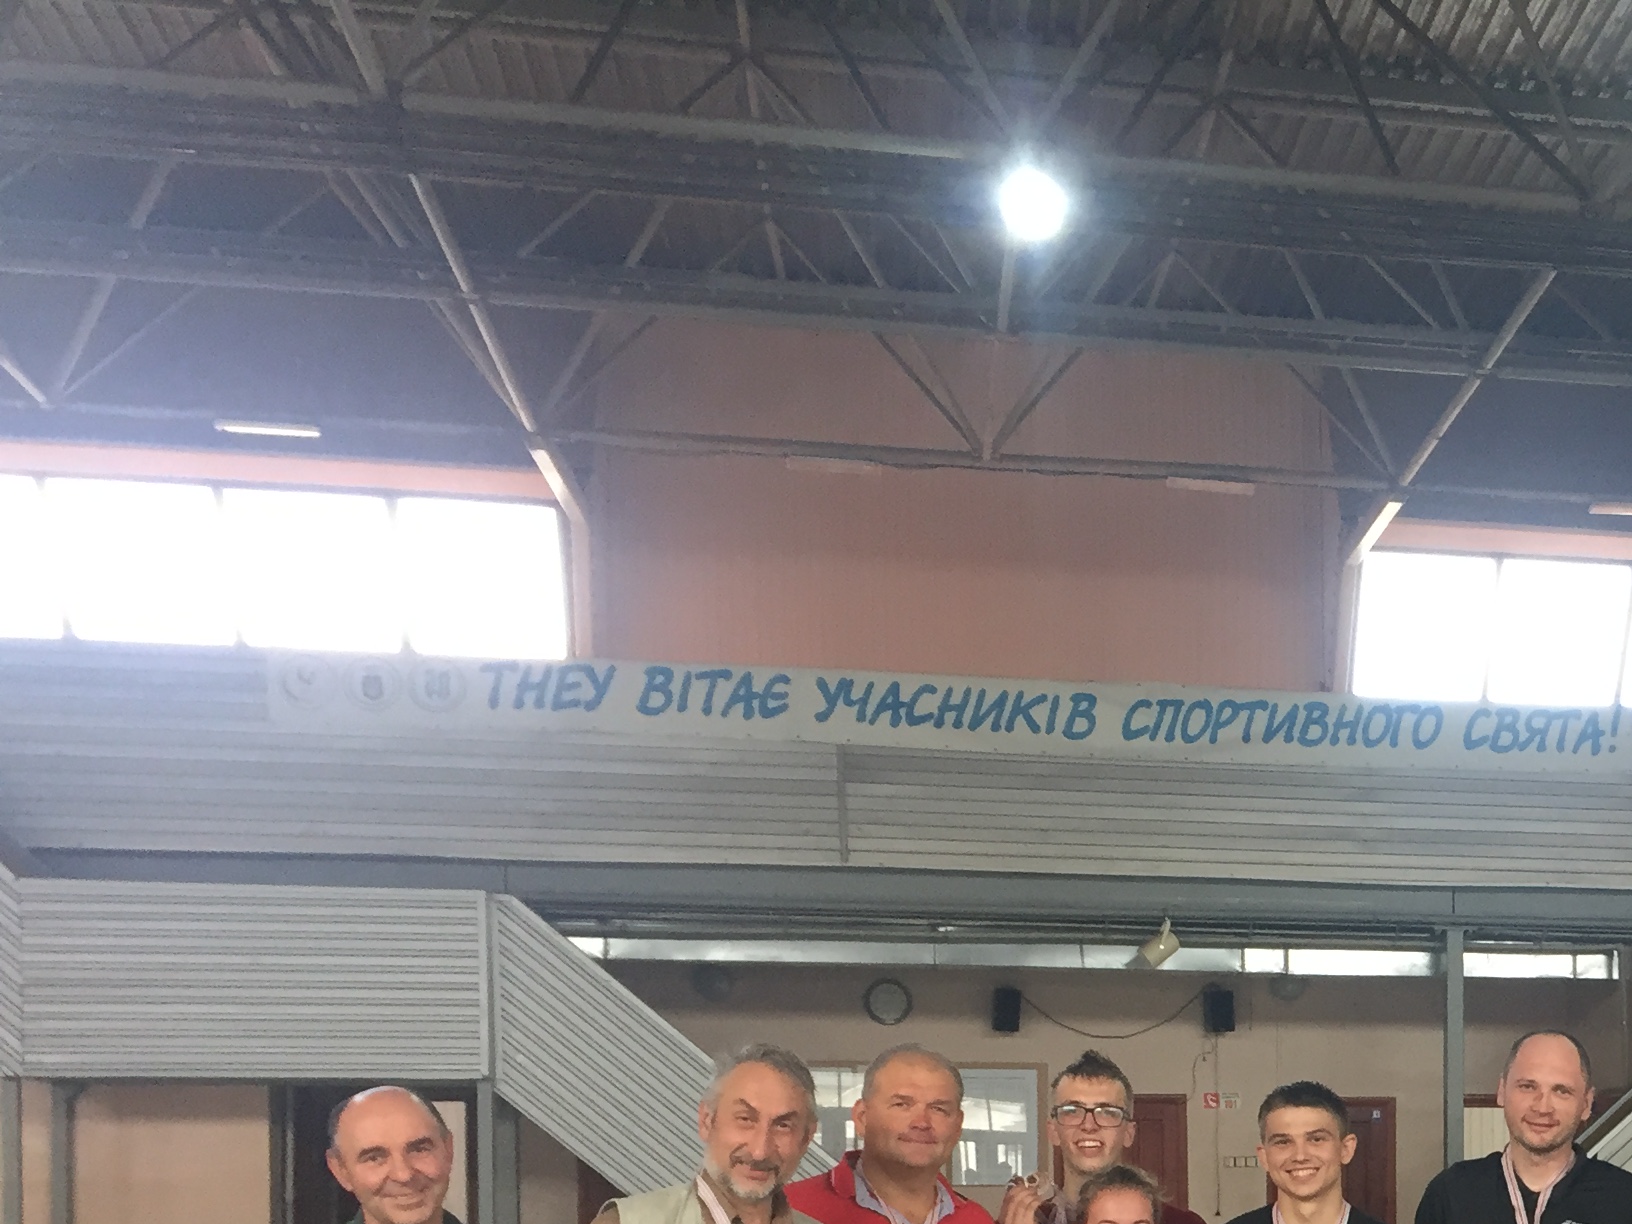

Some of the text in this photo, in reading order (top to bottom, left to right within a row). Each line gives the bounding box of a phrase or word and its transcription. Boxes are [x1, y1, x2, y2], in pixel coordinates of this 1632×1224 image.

[635, 665, 790, 720] ВІТАЄ
[815, 675, 1097, 742] УЧАСНИКІВ
[1121, 697, 1443, 748] СПОРТИВНОГО
[1462, 704, 1622, 756] СВЯТА!
